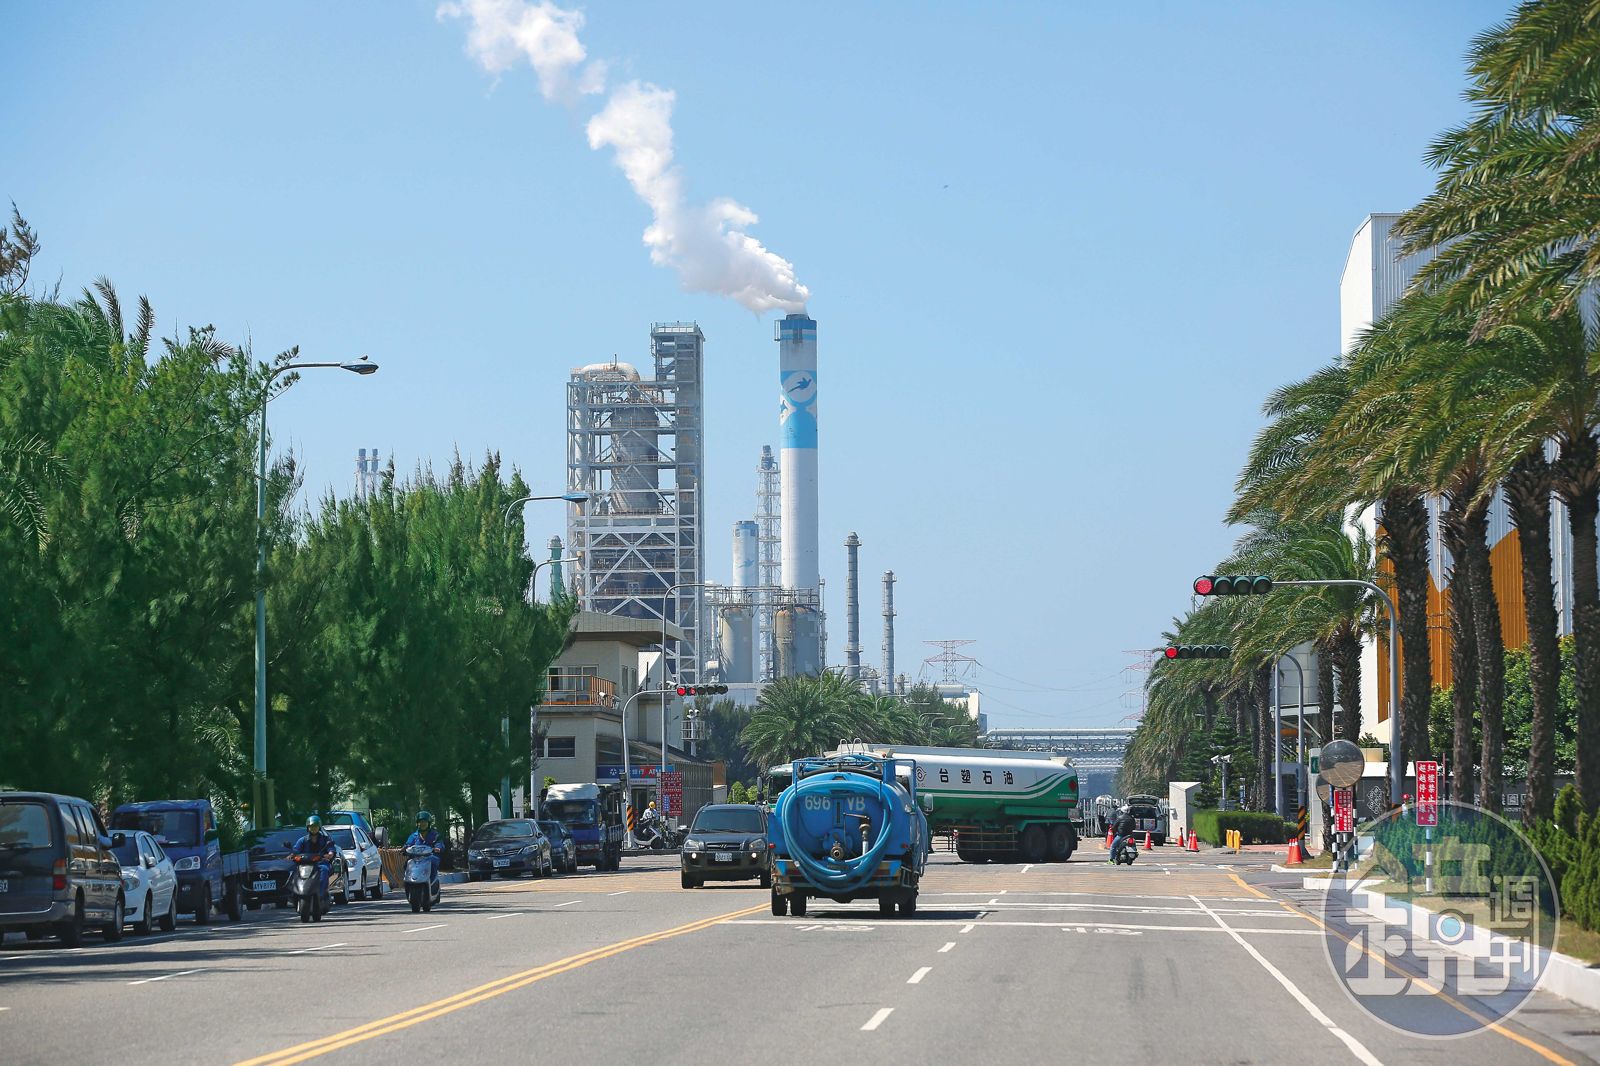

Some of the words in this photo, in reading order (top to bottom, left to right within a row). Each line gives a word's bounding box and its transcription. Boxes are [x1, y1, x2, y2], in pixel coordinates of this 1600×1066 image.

[938, 767, 1014, 785] 台塑石油
[804, 795, 831, 810] 696
[847, 796, 866, 811] VB
